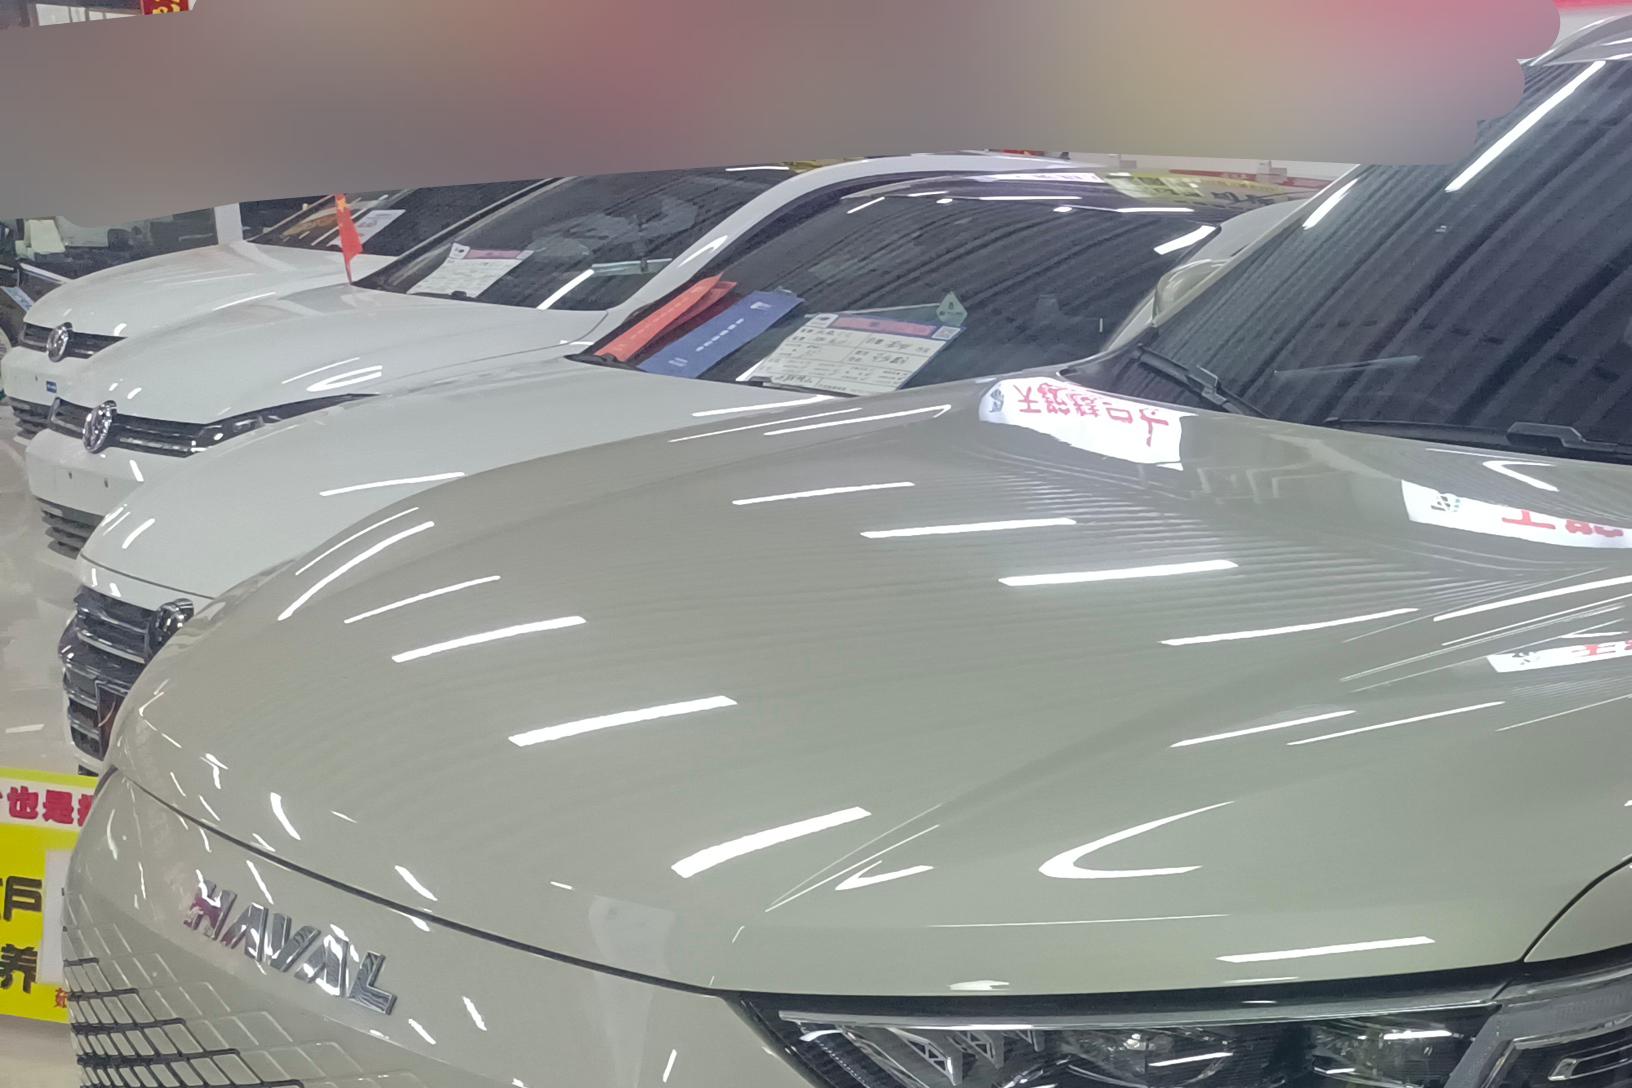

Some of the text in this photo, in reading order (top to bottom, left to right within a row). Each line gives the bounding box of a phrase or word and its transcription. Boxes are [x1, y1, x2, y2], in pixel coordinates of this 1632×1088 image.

[0, 786, 94, 828] 也是
[0, 876, 42, 921] 户
[184, 878, 397, 1015] HAVAL
